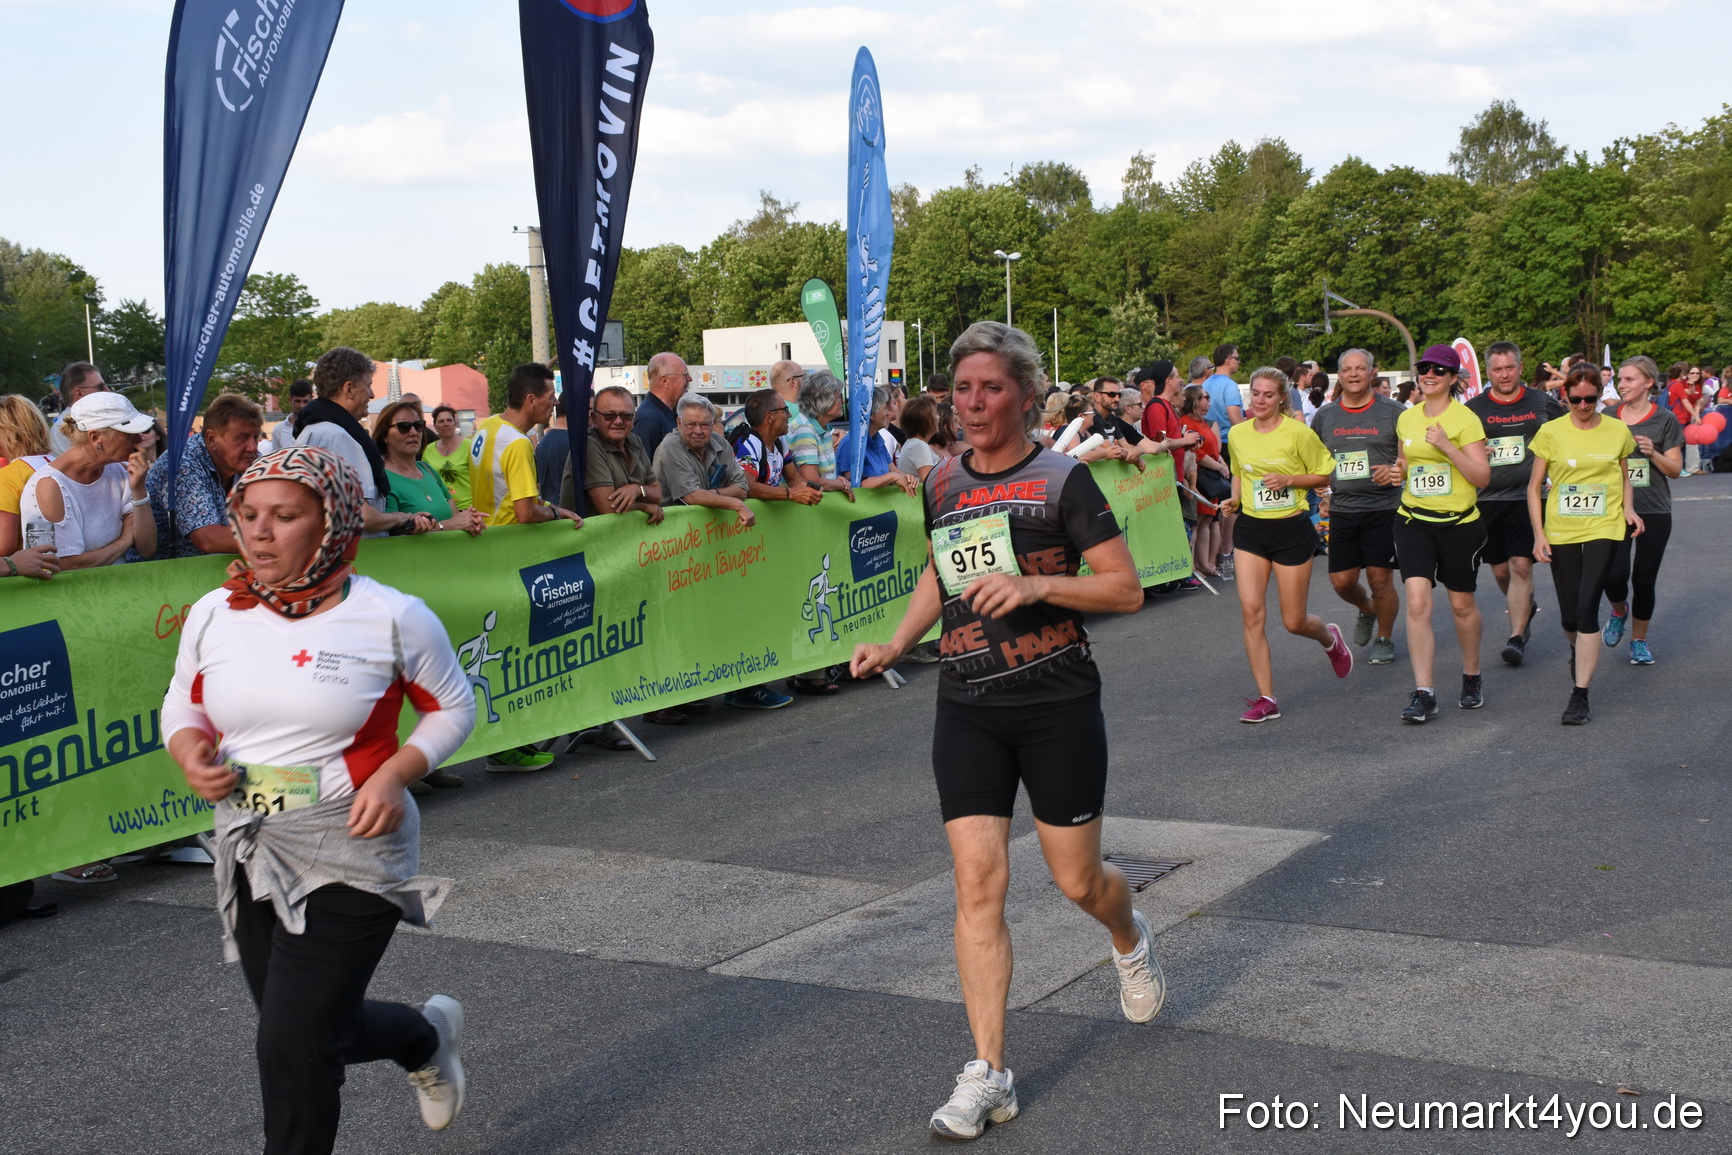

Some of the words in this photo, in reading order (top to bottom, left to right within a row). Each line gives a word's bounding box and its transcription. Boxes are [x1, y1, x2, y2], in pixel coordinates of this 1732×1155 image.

[1487, 411, 1537, 424] Oberbank
[1333, 426, 1380, 437] Oberbank
[472, 435, 484, 458] B
[1338, 461, 1365, 473] 1775
[1413, 475, 1445, 488] 1198
[955, 479, 1048, 511] HAARE
[1258, 488, 1290, 502] 1204
[1564, 496, 1600, 508] 1217
[638, 522, 703, 568] Gesunde
[857, 532, 890, 549] Fischer
[668, 557, 713, 593] laufen
[715, 534, 767, 577] länger!
[951, 541, 996, 573] 975
[541, 579, 584, 602] Fischer
[547, 592, 583, 610] AUTOMOBILE
[843, 607, 886, 635] neumarkt
[501, 599, 648, 698] firmenlauf
[611, 646, 780, 707] www.firmenlauf-oberpfalz.de
[508, 674, 574, 714] neumarkt
